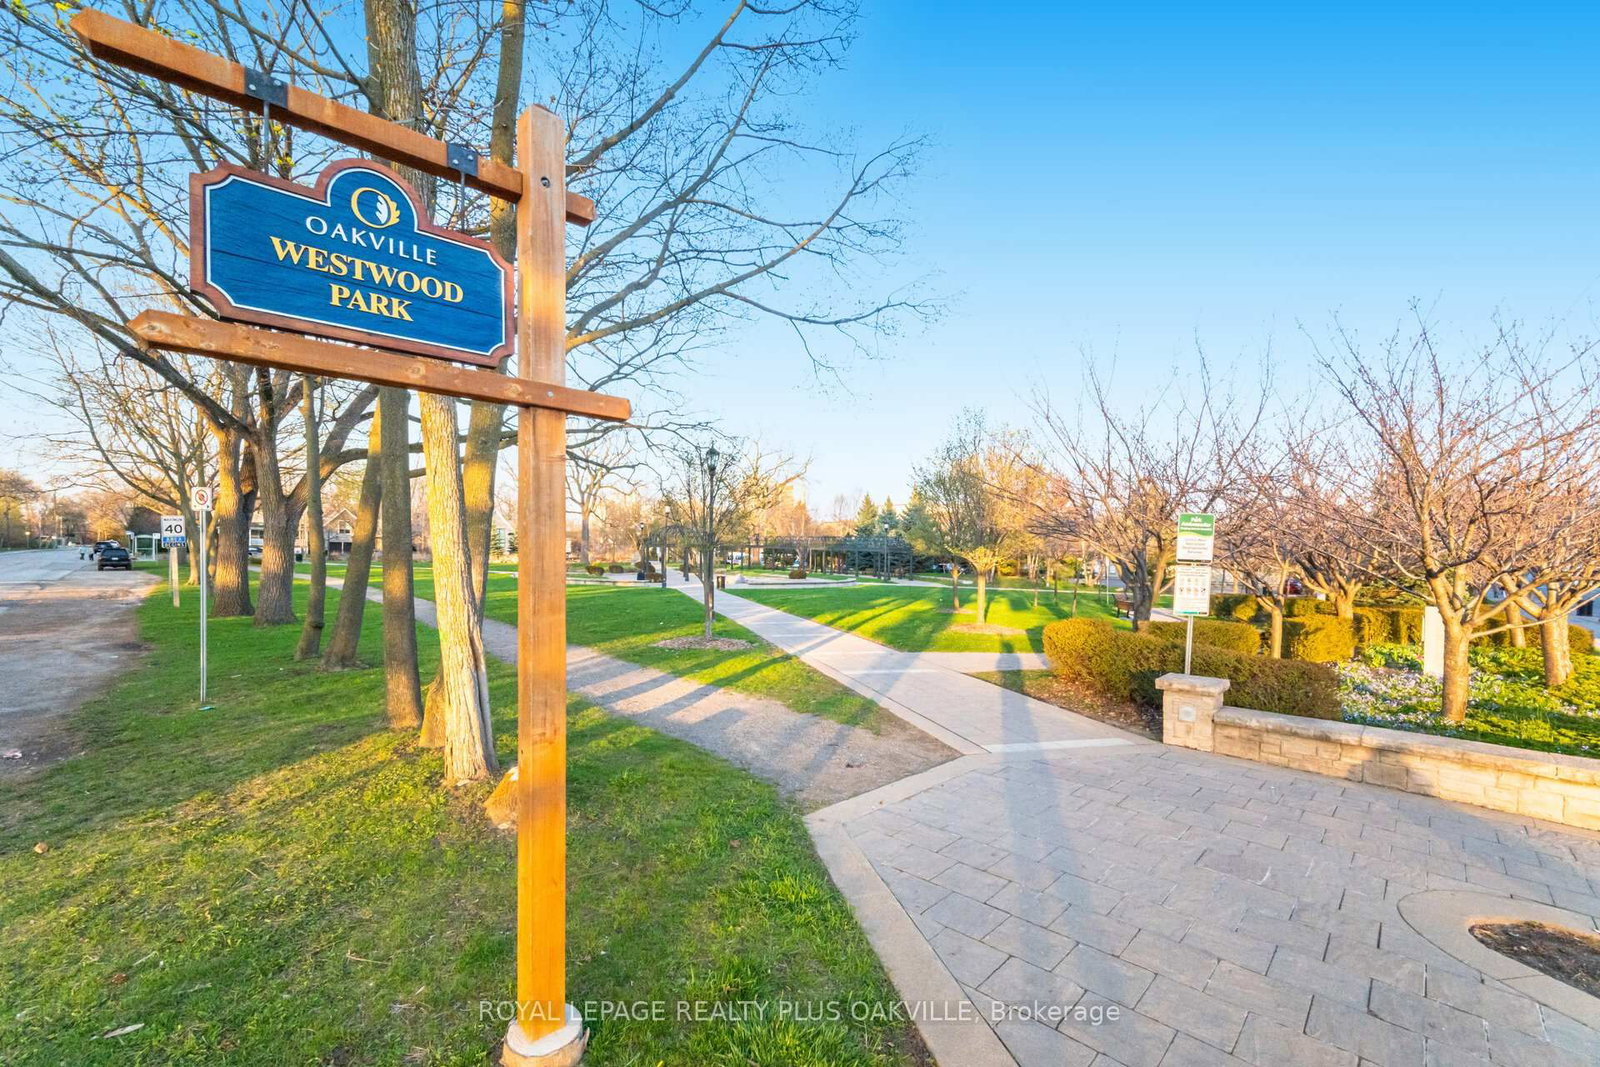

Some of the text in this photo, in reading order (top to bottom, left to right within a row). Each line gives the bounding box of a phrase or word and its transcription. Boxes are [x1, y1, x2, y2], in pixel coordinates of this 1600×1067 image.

[305, 215, 437, 266] OAKVILLE
[269, 236, 464, 303] WESTWOOD
[329, 283, 414, 322] PARK
[165, 524, 183, 534] 40
